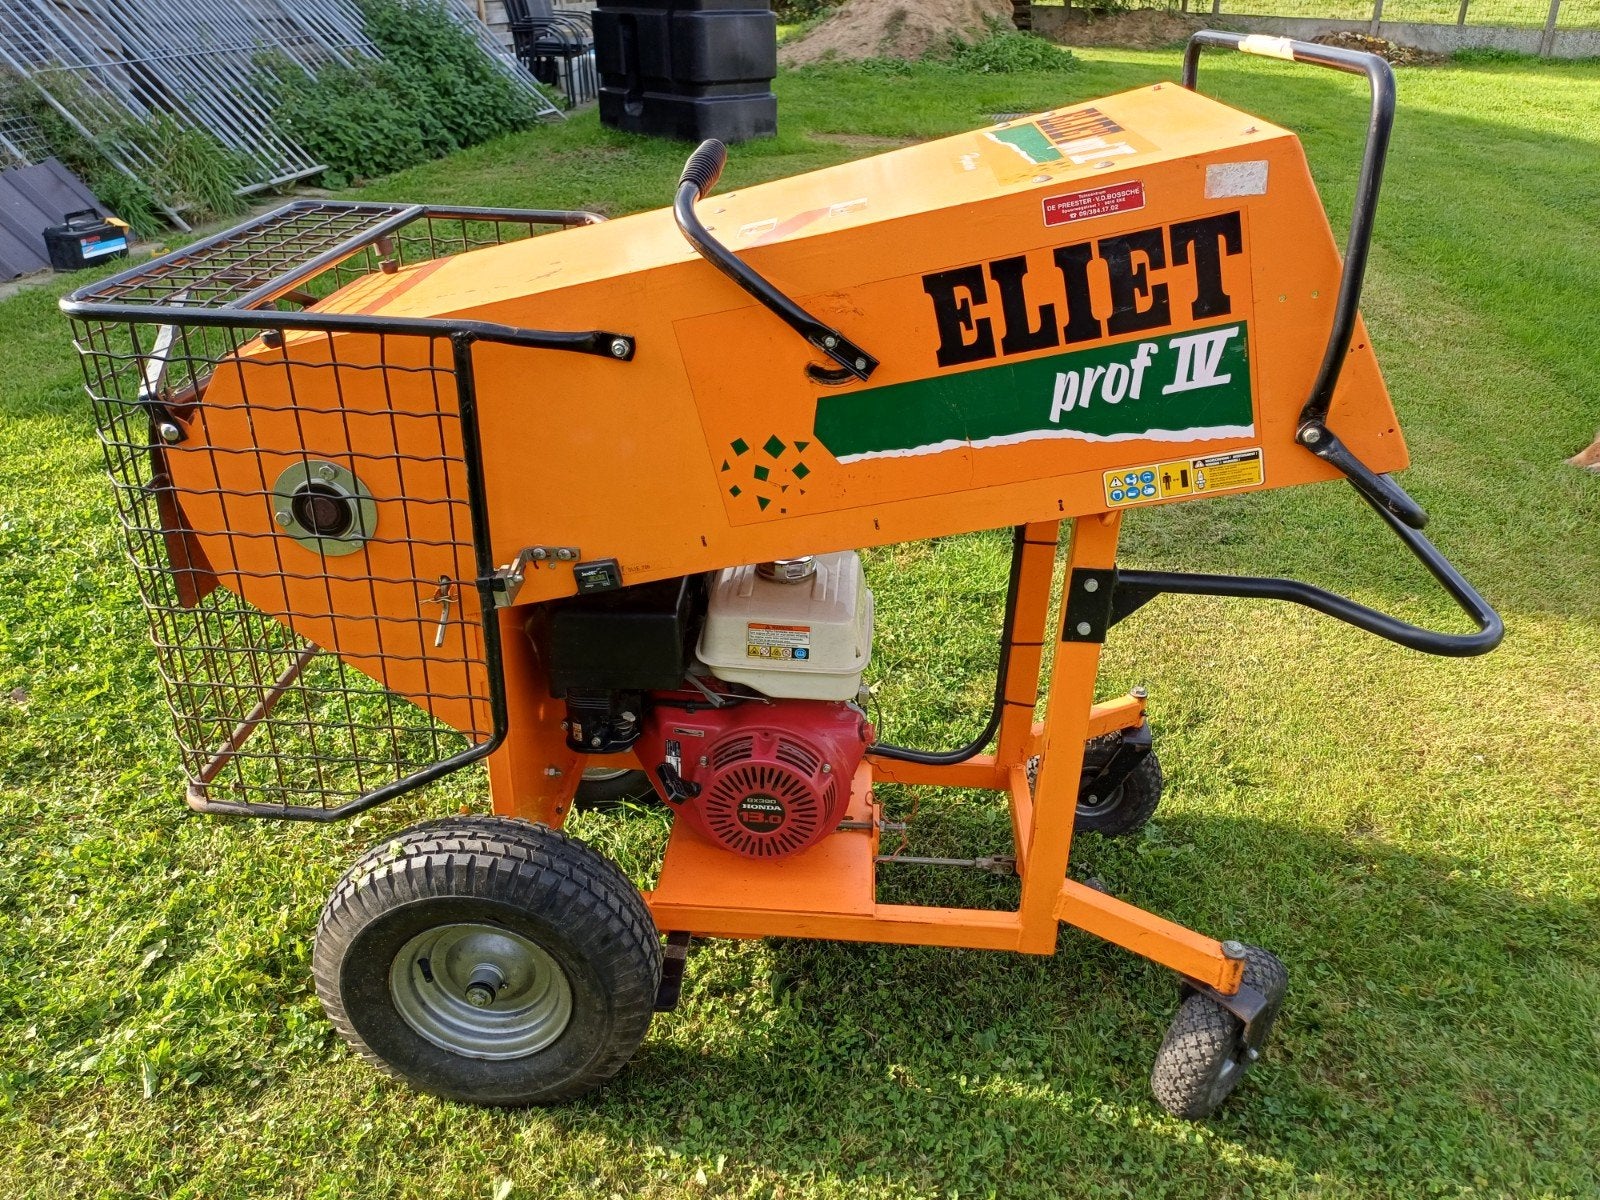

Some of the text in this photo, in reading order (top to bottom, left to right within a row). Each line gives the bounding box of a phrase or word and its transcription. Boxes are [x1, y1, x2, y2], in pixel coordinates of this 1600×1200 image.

[1057, 197, 1092, 210] PREESTER
[922, 211, 1242, 367] ELIET
[1050, 327, 1239, 422] prof IV
[742, 803, 782, 811] HONDA
[740, 811, 782, 824] 13.0
